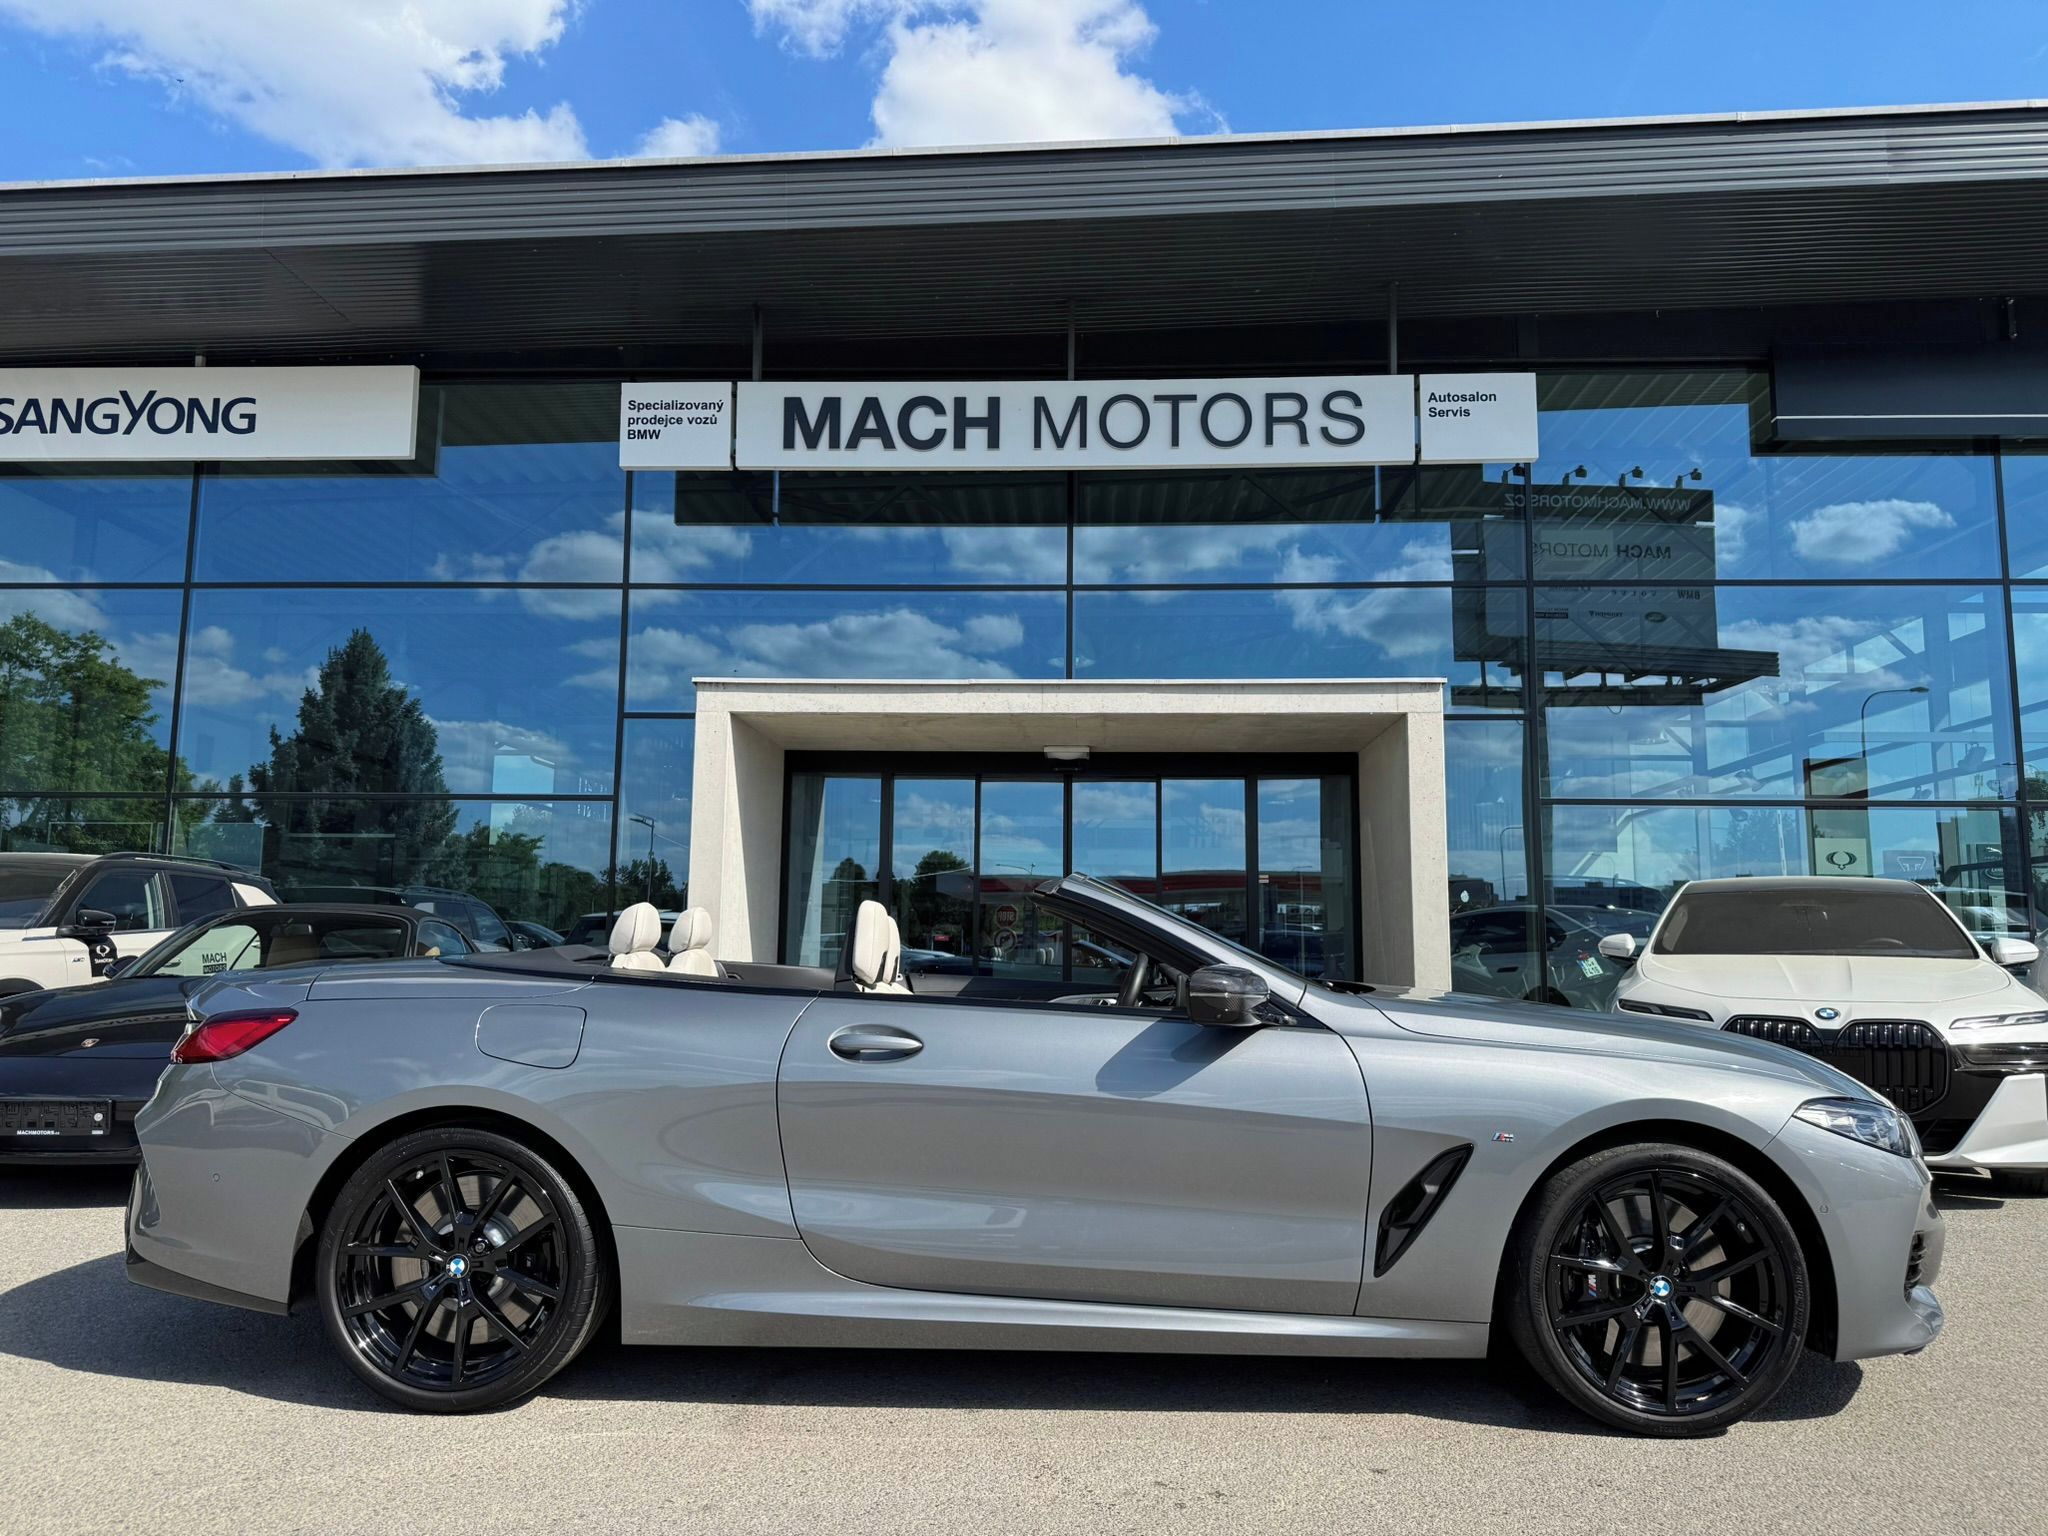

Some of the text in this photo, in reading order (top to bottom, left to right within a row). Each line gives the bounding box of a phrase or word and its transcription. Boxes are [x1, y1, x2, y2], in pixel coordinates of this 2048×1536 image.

[1428, 391, 1497, 403] Autosalon
[0, 390, 257, 435] SANGYONG
[628, 399, 724, 413] Specializovaný
[1428, 406, 1471, 418] Servis
[627, 414, 718, 428] prodejce vozů
[782, 390, 1366, 451] MACH MOTORS
[627, 429, 661, 440] BMW
[202, 952, 227, 964] MACH
